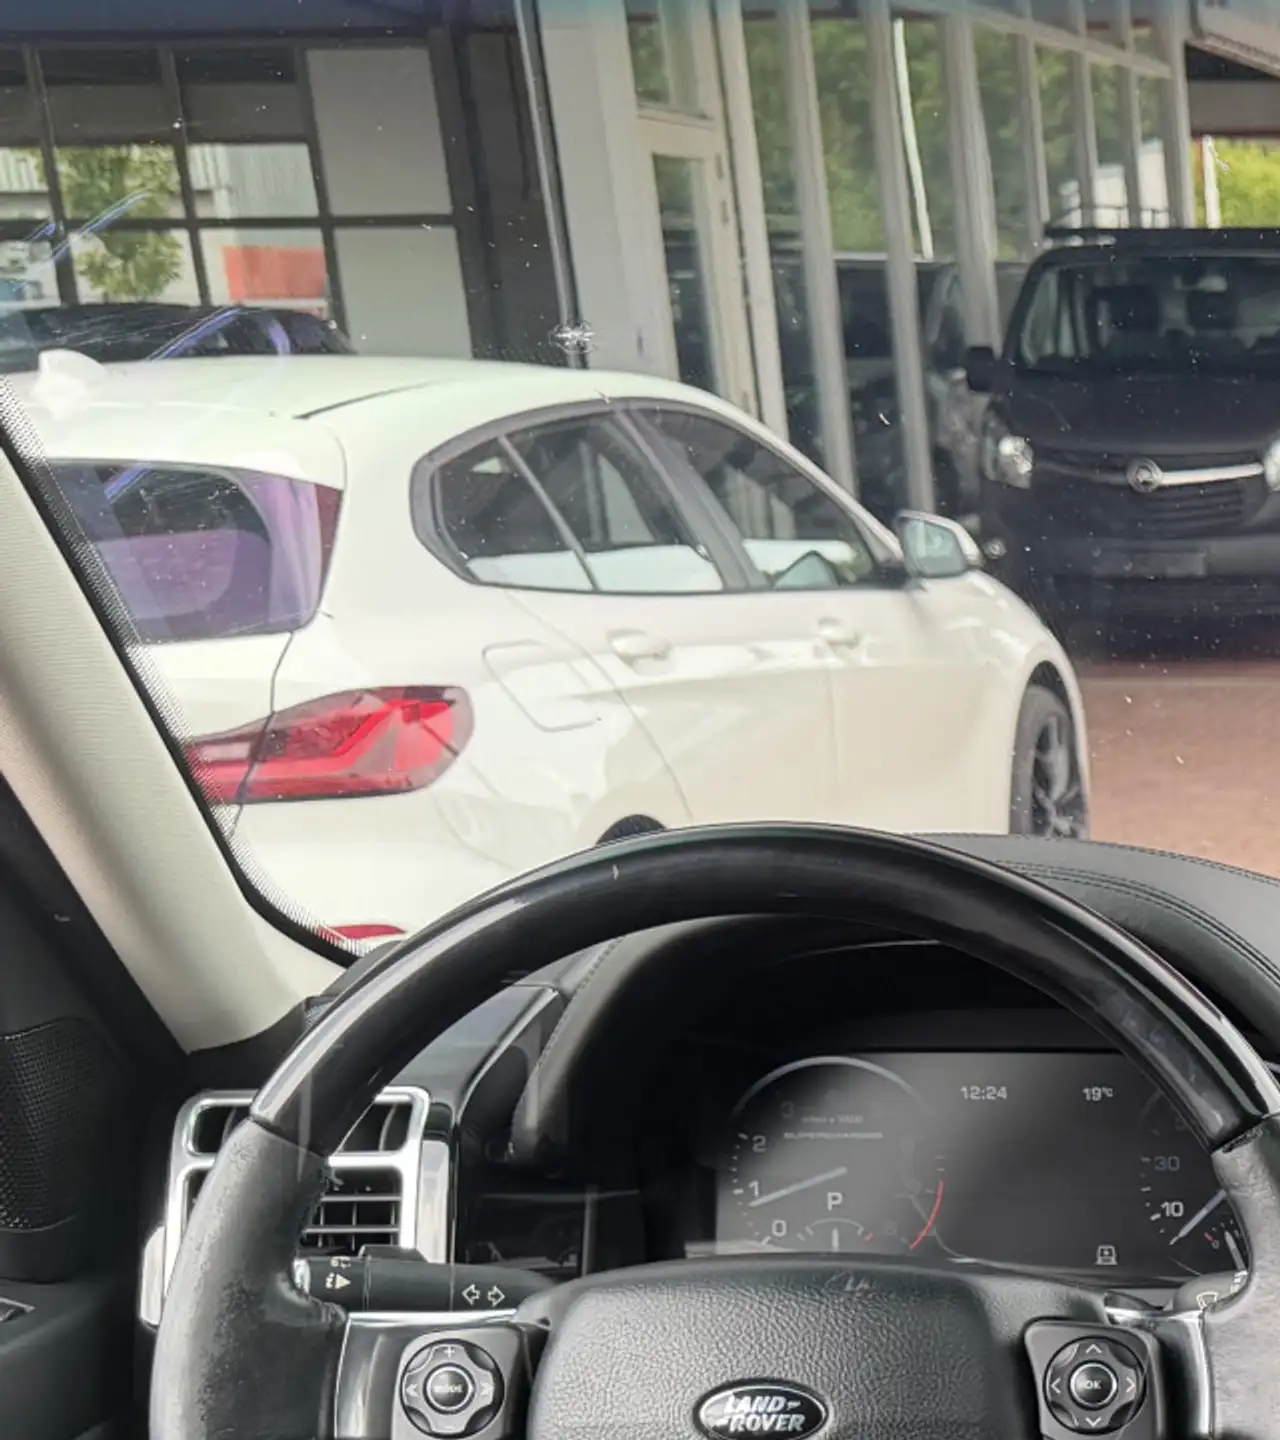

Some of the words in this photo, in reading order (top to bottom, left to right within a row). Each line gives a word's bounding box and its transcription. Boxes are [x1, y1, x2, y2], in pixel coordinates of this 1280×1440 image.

[960, 1086, 1008, 1100] 12:24
[752, 1135, 767, 1153] 2
[1154, 1156, 1180, 1171] 30
[748, 1180, 760, 1198] 1
[826, 1192, 843, 1211] P
[1160, 1201, 1184, 1217] 10
[772, 1219, 787, 1237] 0
[1084, 1380, 1101, 1389] OK
[724, 1394, 787, 1413] LAND
[729, 1414, 806, 1432] ROVER
